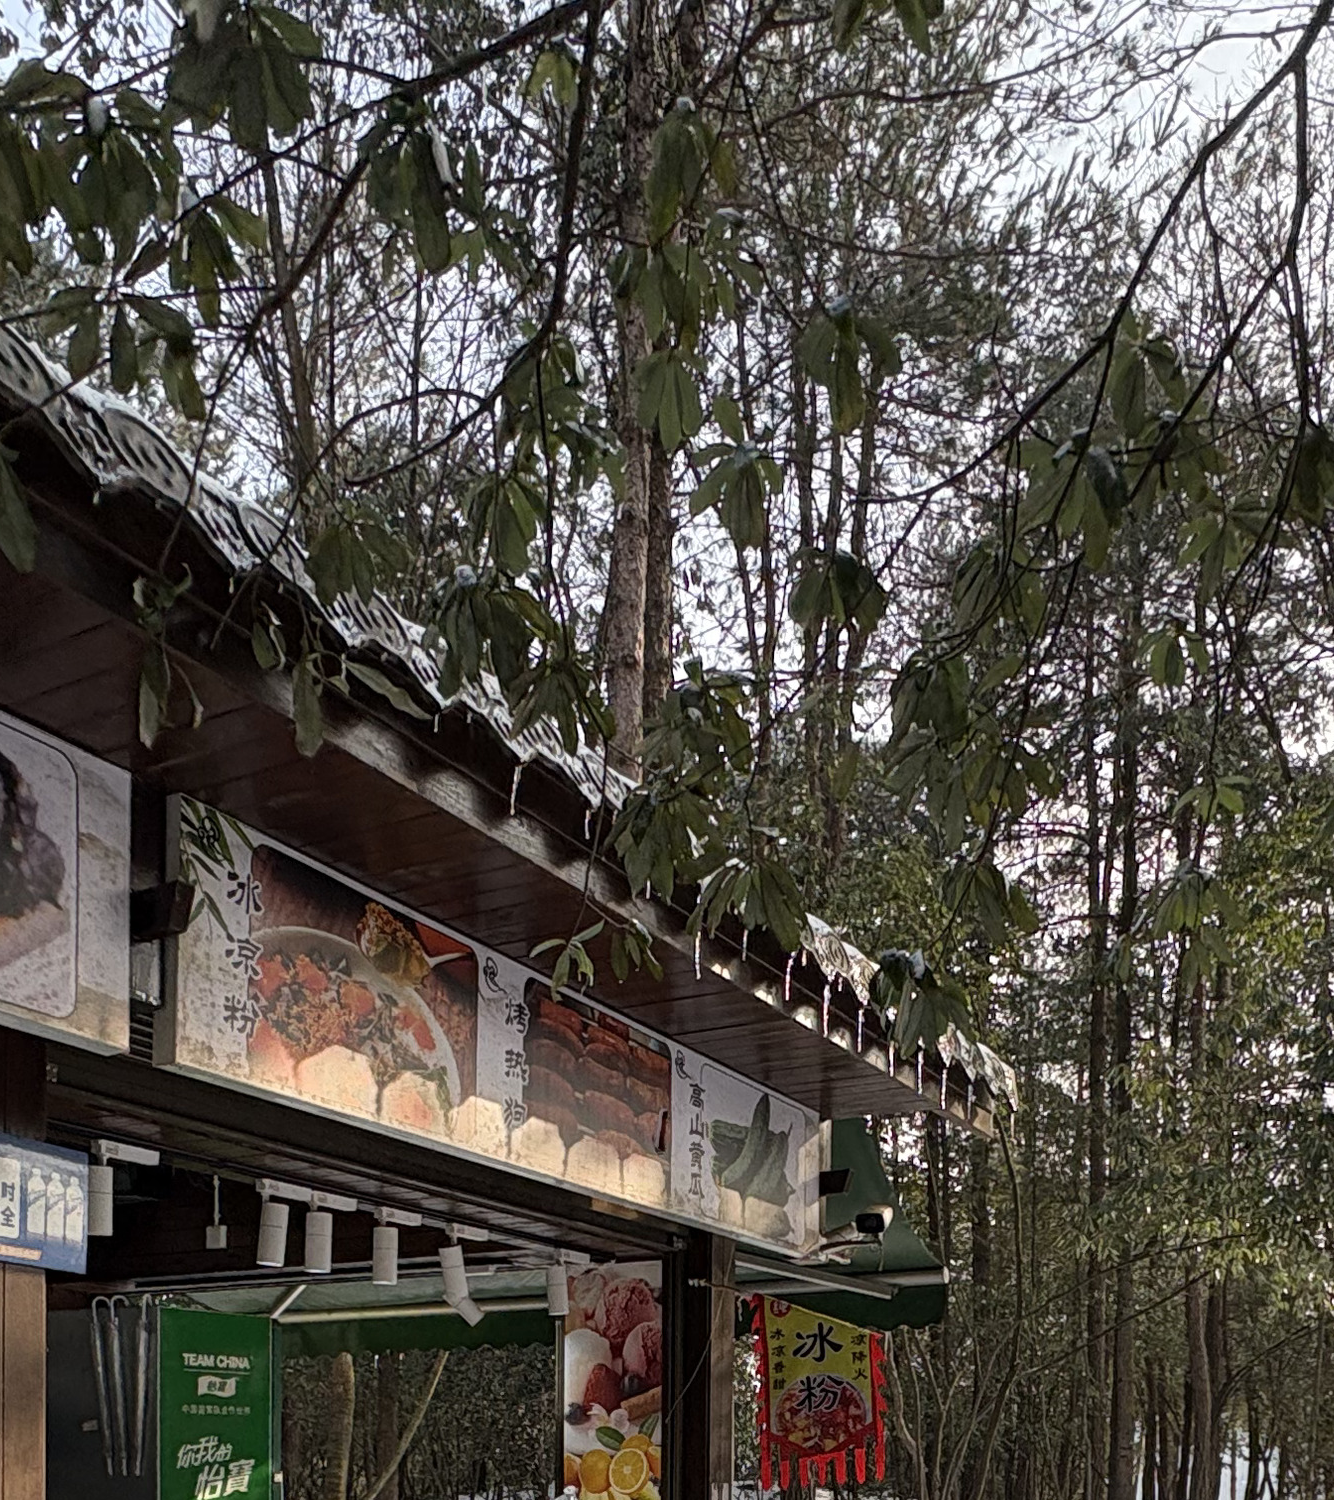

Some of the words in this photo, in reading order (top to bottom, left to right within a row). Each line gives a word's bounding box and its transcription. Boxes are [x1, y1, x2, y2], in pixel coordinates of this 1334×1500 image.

[223, 871, 263, 1039] 冰凉粉
[504, 999, 530, 1128] 烤热狗
[689, 1084, 707, 1199] 高山黄瓜
[182, 1353, 215, 1368] TEAM
[216, 1355, 251, 1370] CHINA
[792, 1322, 846, 1412] 冰粉
[177, 1436, 233, 1469] 你我的
